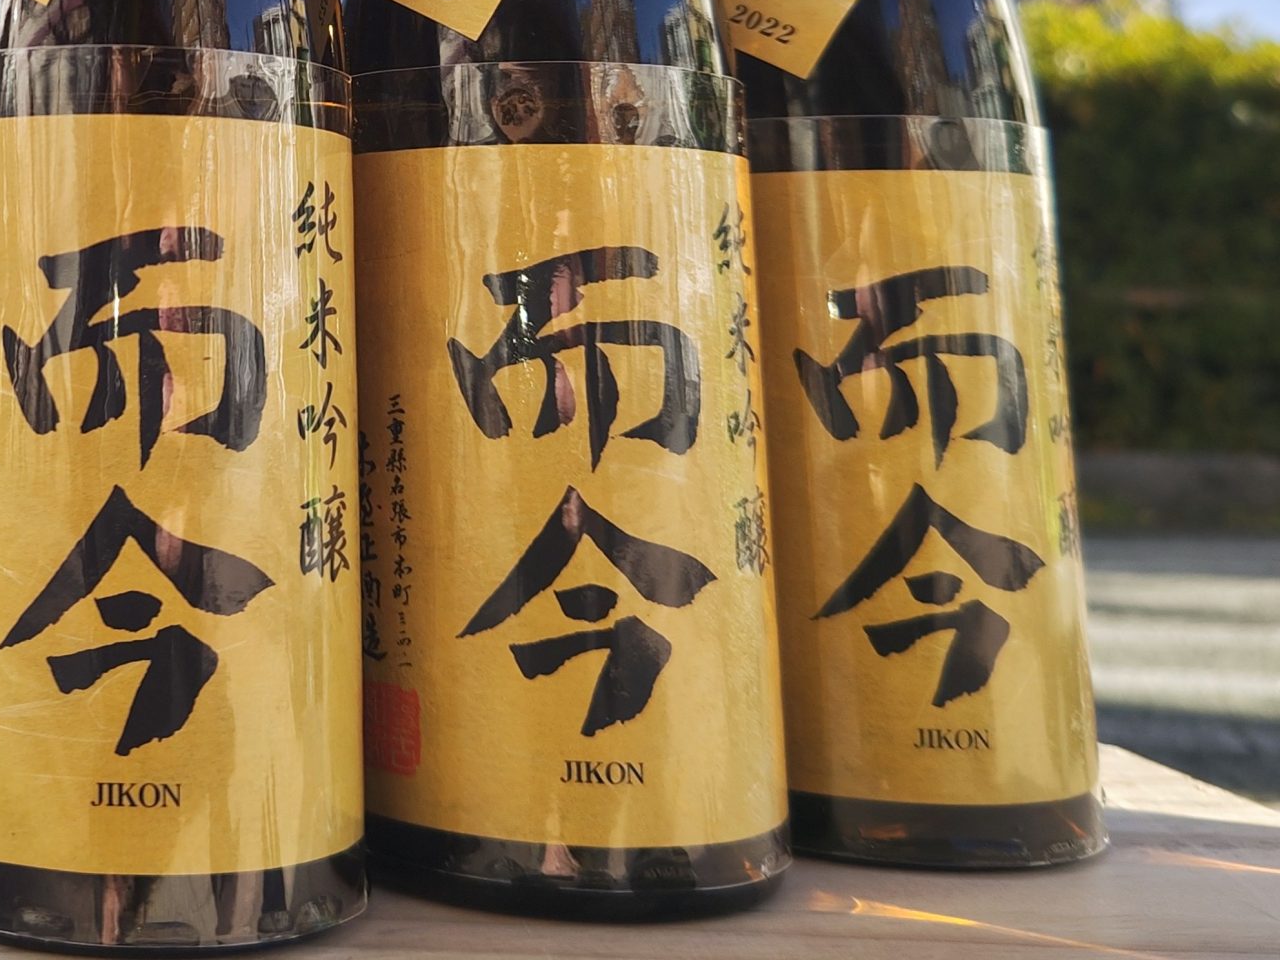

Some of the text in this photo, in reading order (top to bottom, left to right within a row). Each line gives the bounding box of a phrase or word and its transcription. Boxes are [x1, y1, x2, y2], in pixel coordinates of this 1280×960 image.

[727, 3, 796, 46] 2022
[447, 245, 718, 737] 而今
[793, 265, 1047, 708] 而今
[913, 728, 991, 750] JIKON
[559, 759, 645, 785] JIKON
[90, 782, 182, 808] JIKON
